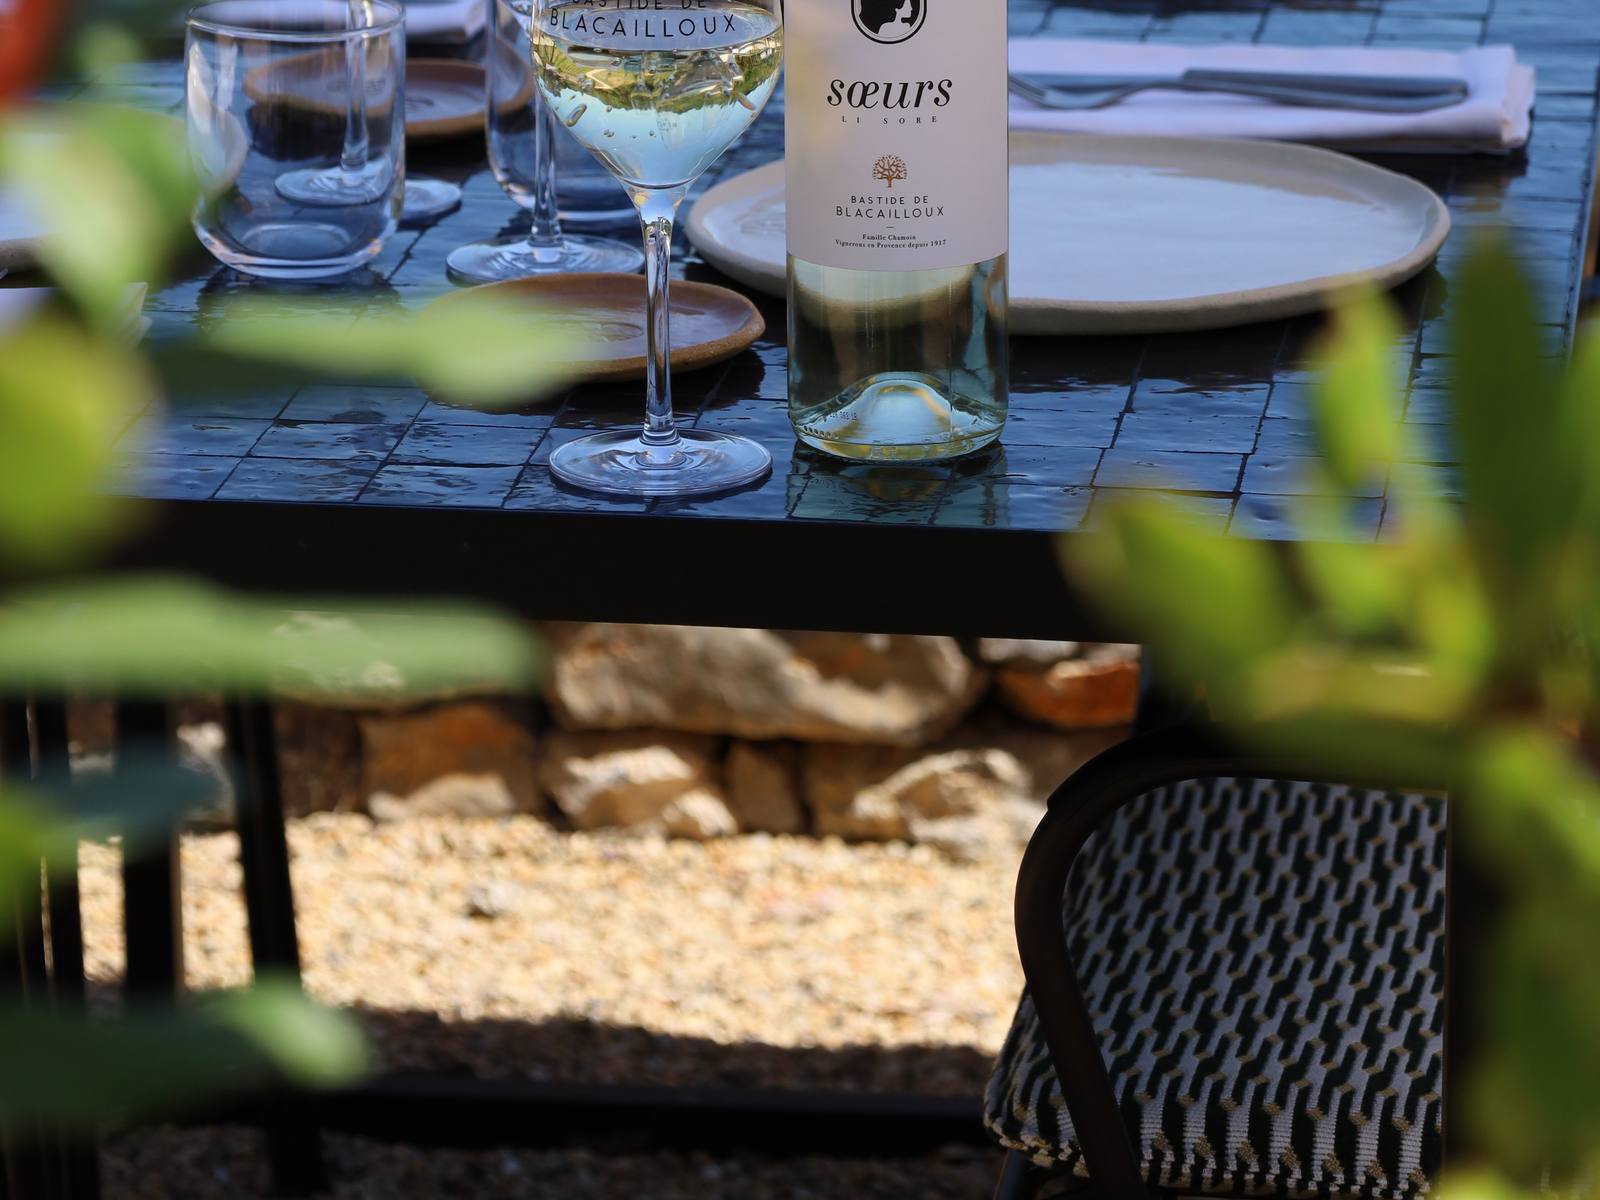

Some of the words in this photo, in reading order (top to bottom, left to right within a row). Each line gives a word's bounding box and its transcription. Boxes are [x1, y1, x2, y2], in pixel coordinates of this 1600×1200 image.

[550, 7, 736, 38] BLACAILLOUX
[826, 78, 953, 110] sœurs
[850, 195, 905, 205] BASTIDE
[914, 195, 929, 205] DE
[836, 205, 944, 219] BLACAILLOUX
[835, 239, 866, 248] Vignerons
[876, 241, 906, 249] Provence
[907, 241, 929, 249] depuis
[930, 239, 947, 247] 1917
